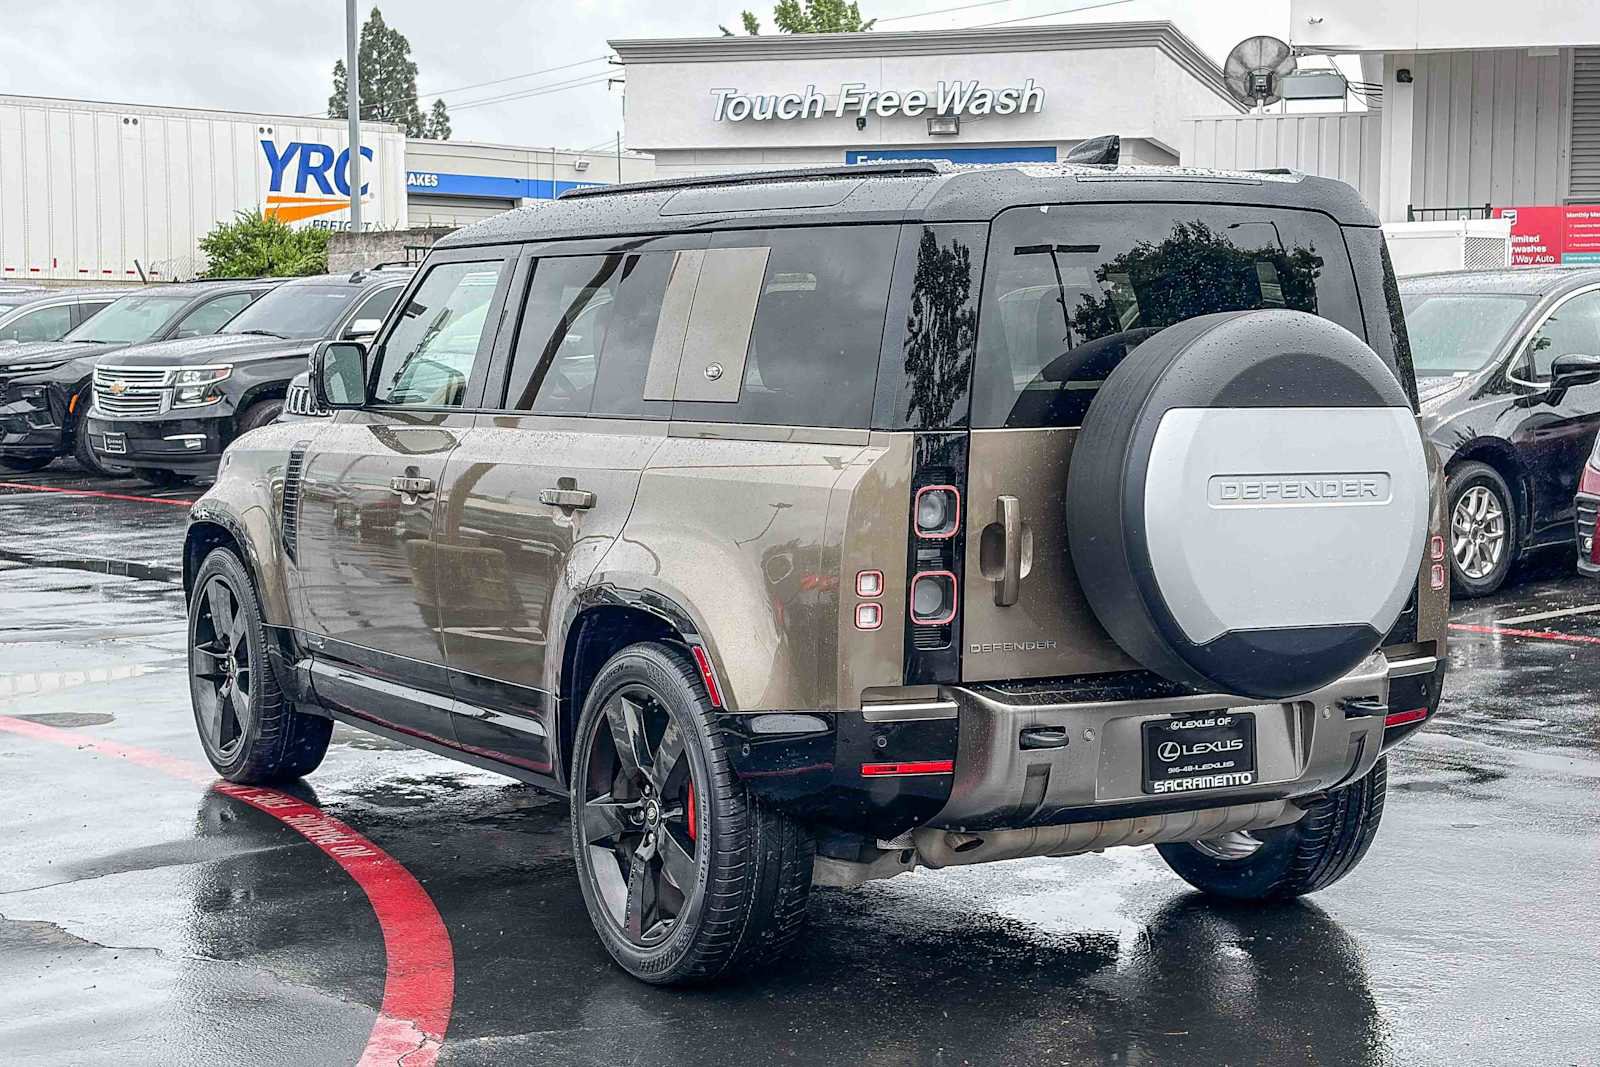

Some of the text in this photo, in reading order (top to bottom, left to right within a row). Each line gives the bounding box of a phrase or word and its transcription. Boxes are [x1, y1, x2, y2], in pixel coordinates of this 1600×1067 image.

[709, 78, 1046, 122] Touch Free Wash
[260, 139, 374, 197] YRC
[407, 172, 438, 187] AKES
[1511, 235, 1540, 243] limited
[1511, 245, 1547, 253] rwashes
[1516, 255, 1534, 264] Way
[1535, 255, 1555, 263] Auto
[1220, 479, 1378, 500] DEFENDER
[970, 640, 1057, 653] DEFENDER
[1180, 717, 1232, 729] LEXUS OF
[1182, 739, 1244, 756] LEXUS
[1153, 772, 1252, 793] SACRAMENTO
